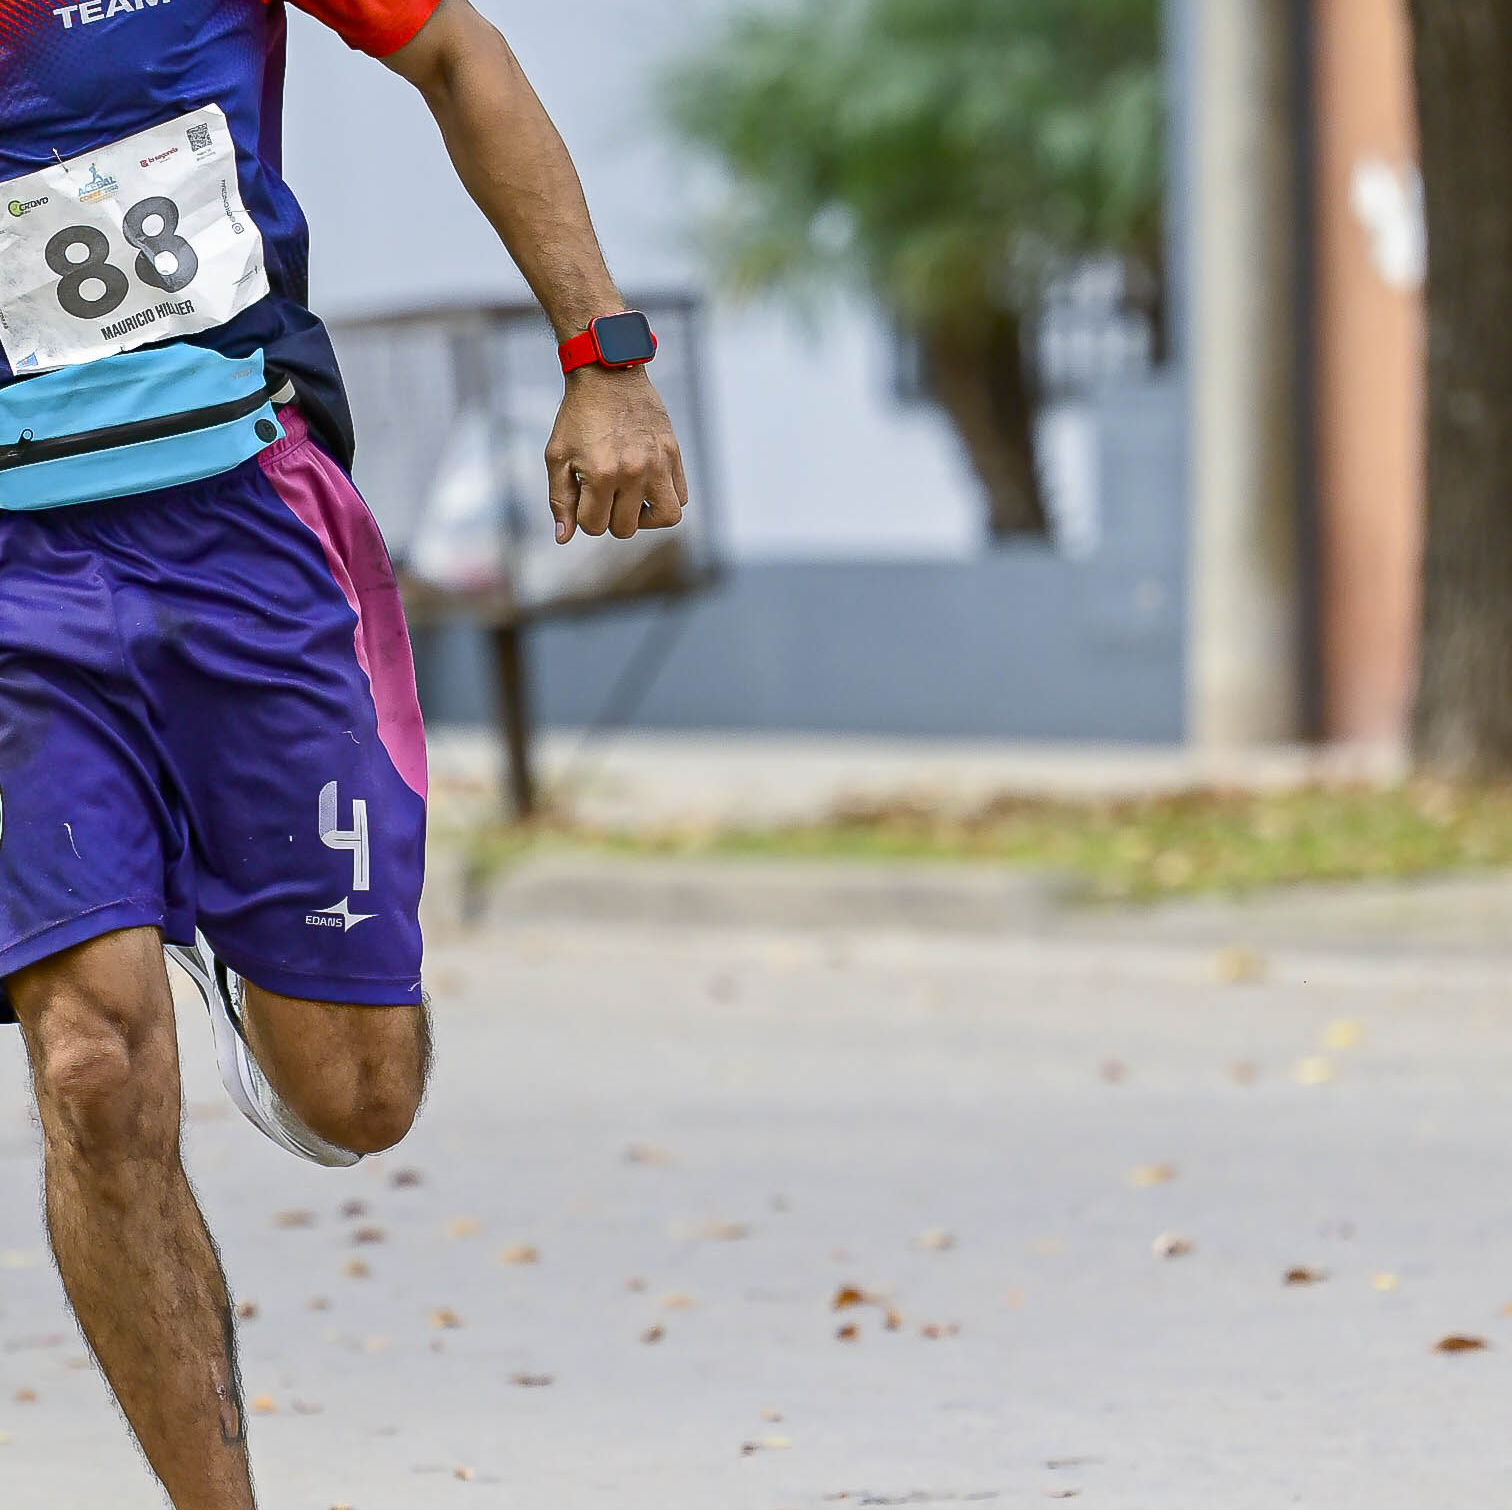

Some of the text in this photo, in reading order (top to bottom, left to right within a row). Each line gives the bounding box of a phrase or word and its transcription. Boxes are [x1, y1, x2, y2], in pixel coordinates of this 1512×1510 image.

[45, 196, 199, 319] 88
[100, 308, 156, 341] MAURICIO
[318, 780, 370, 891] 4
[305, 915, 343, 928] EDANS
